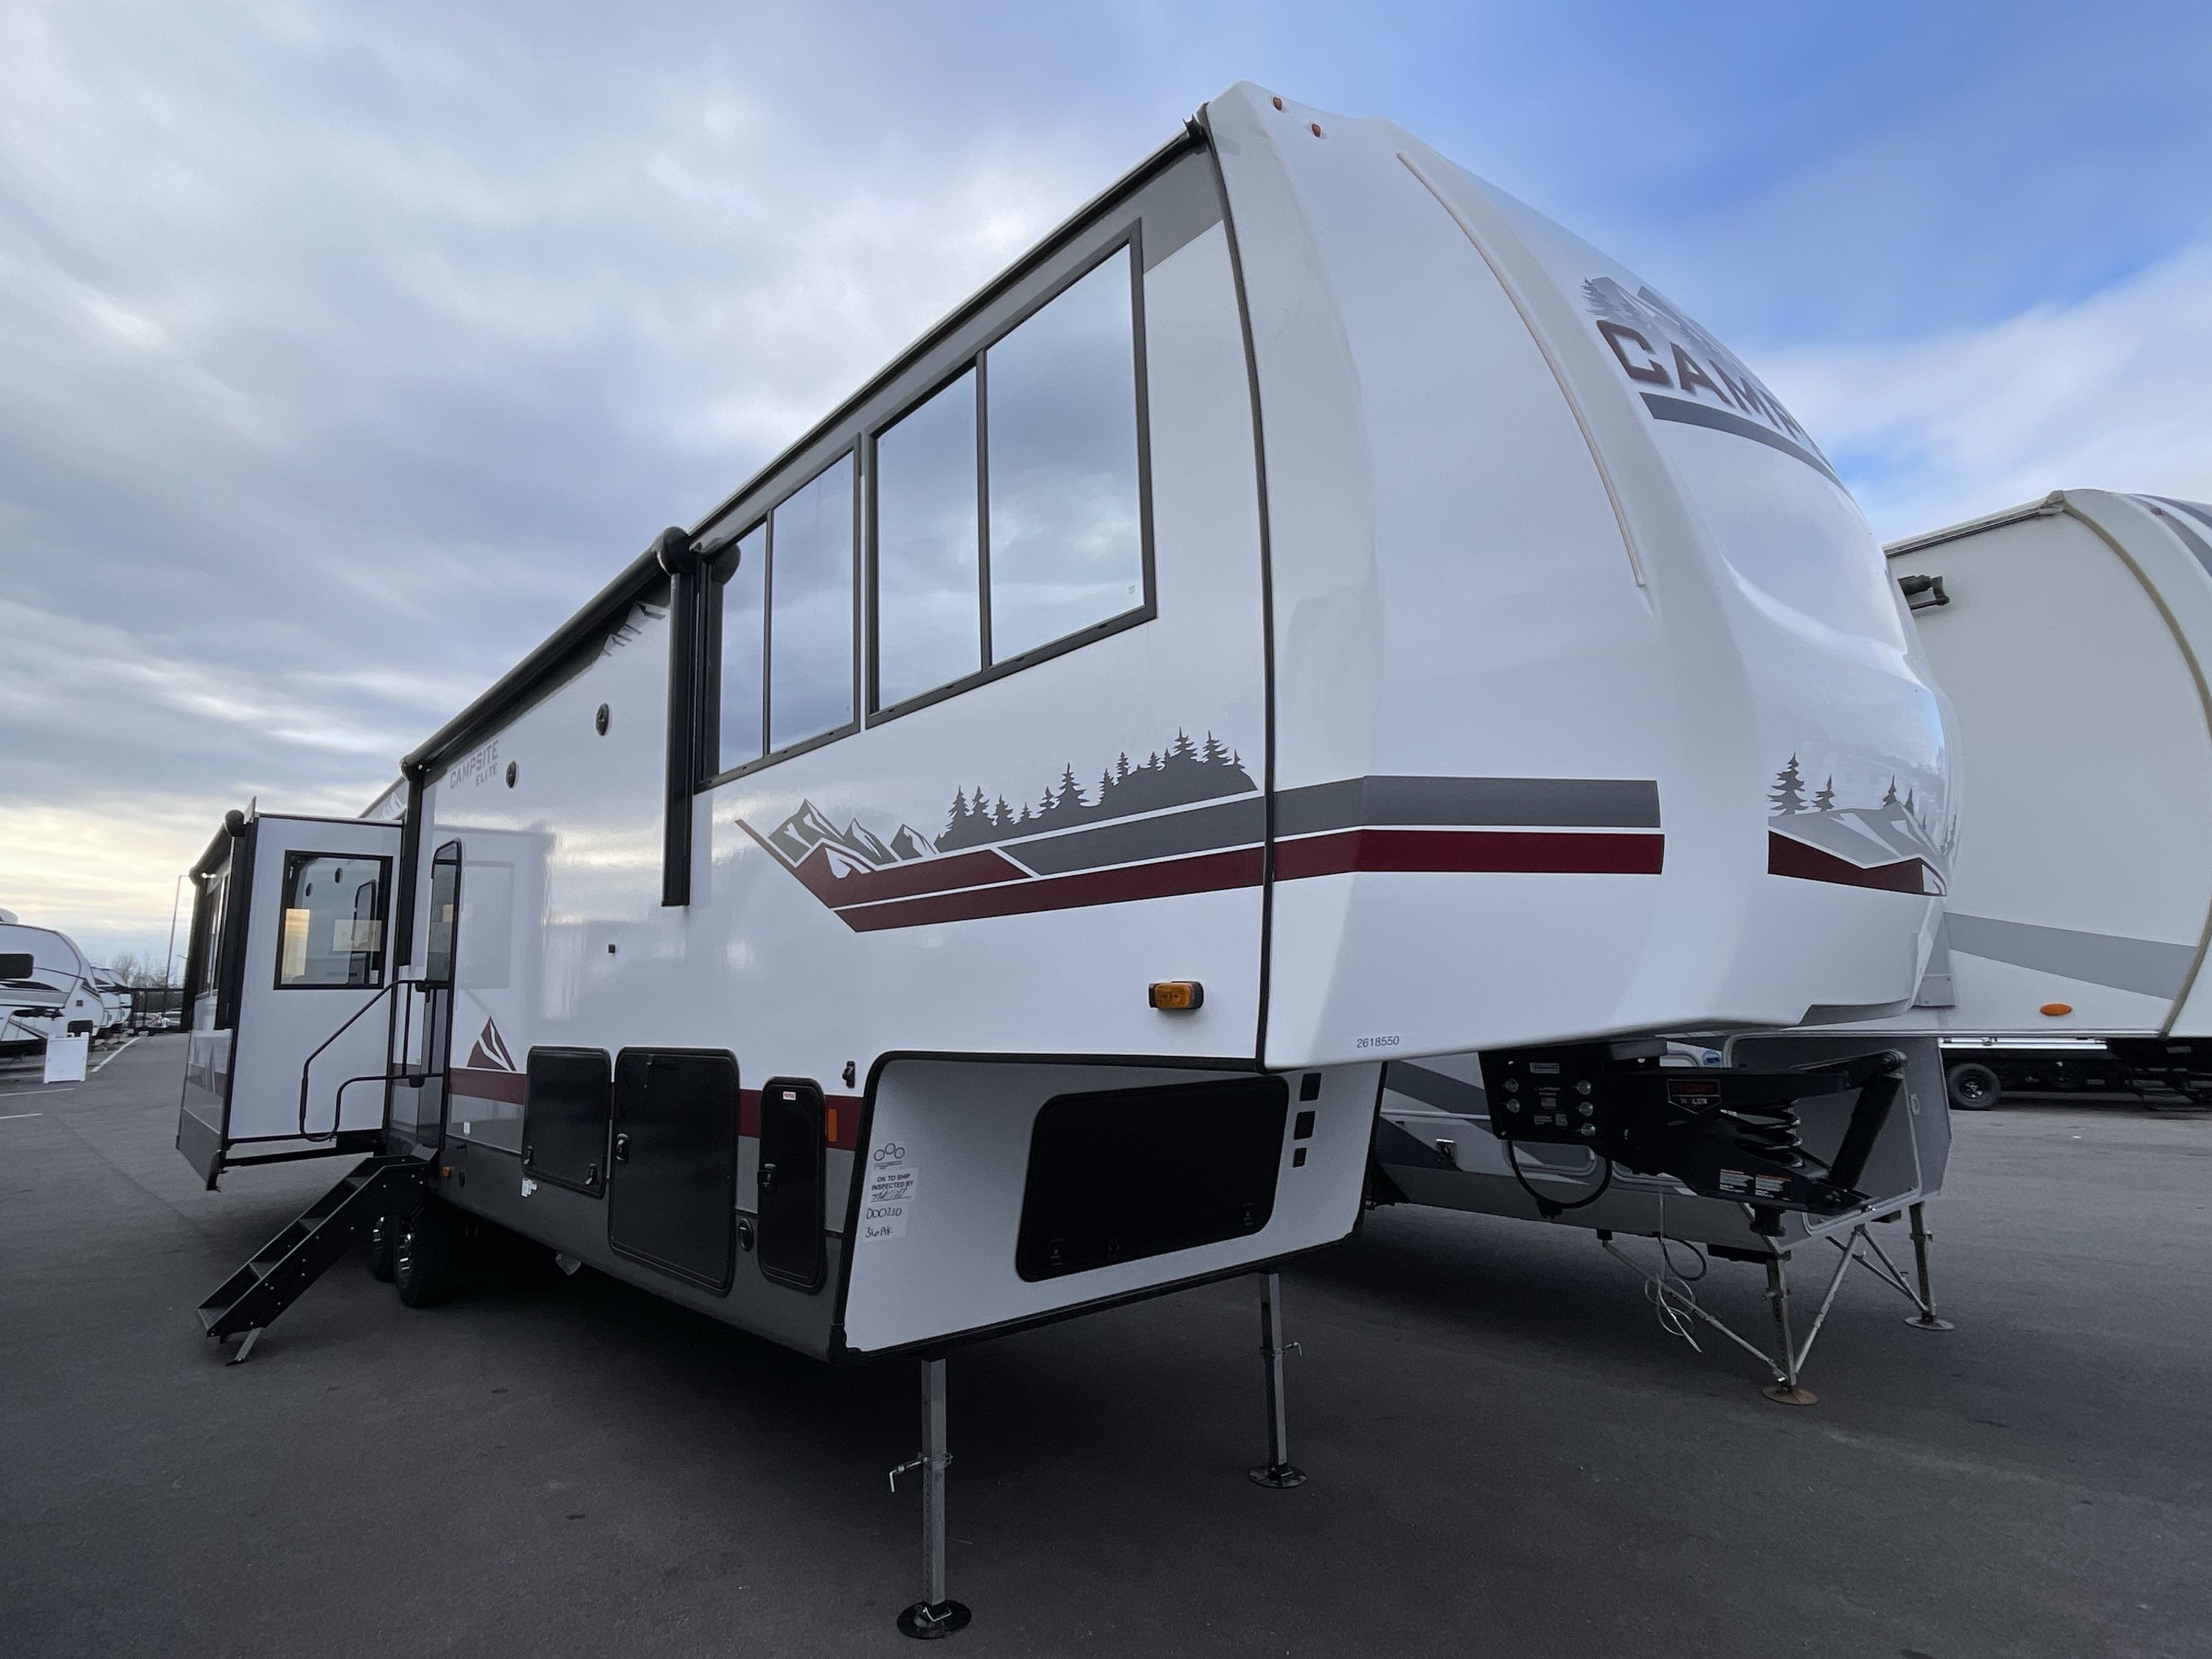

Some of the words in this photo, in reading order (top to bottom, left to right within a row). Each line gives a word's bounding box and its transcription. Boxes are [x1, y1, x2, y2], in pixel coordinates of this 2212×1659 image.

[450, 739, 498, 790] CAMPSITE
[476, 762, 498, 787] ELITE
[1357, 1036, 1399, 1048] 2618550
[872, 1181, 905, 1191] INSPECTED
